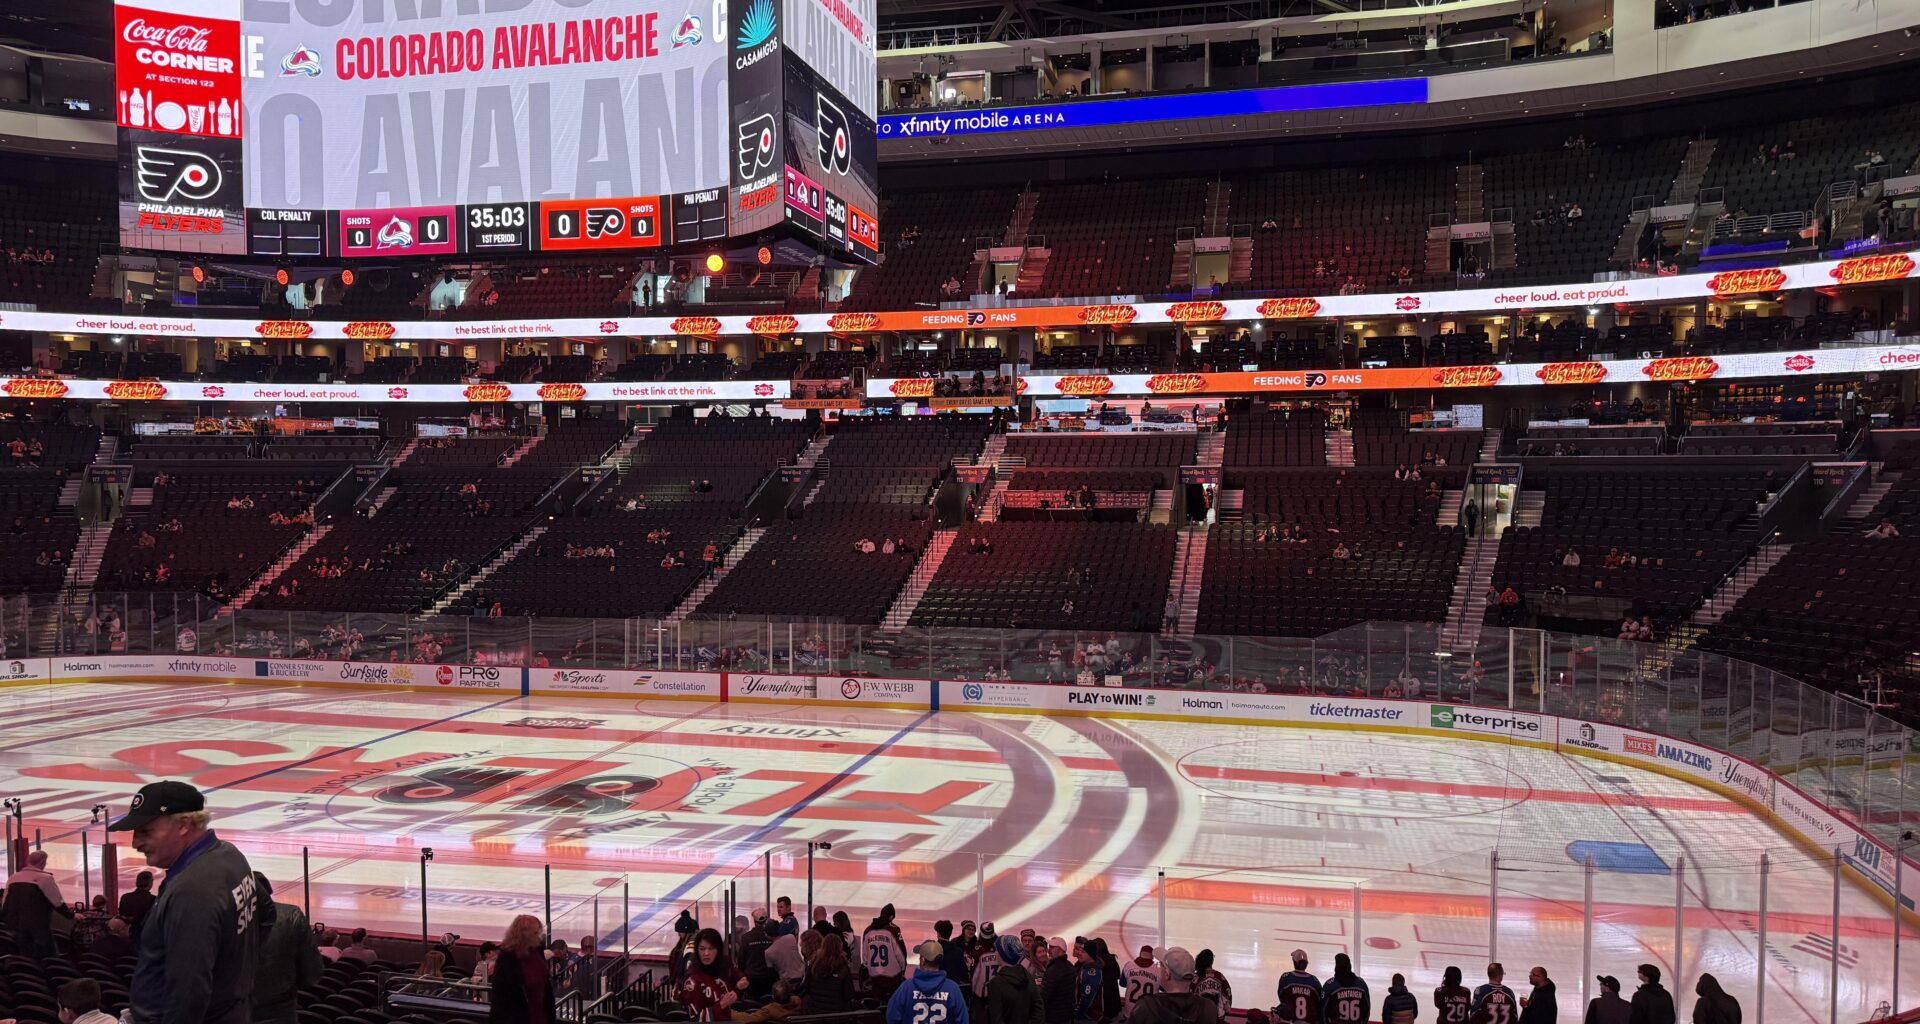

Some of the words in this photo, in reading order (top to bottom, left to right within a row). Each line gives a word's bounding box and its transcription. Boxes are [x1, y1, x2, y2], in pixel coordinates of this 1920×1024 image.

[123, 19, 213, 52] Coca-Cola
[336, 28, 483, 80] COLORADO
[492, 12, 658, 70] AVALANCHE
[736, 37, 778, 70] CASAMIGOS
[136, 48, 234, 74] CORNER
[145, 73, 157, 81] AT
[158, 75, 198, 86] SECTION
[900, 116, 951, 136] xfinity
[954, 112, 1009, 131] mobile
[1012, 112, 1065, 126] ARENA
[739, 172, 778, 195] PHILADELPHIA
[684, 193, 694, 205] PHI
[695, 189, 719, 204] PENALTY
[739, 184, 778, 213] FLYERS
[812, 190, 817, 208] 0
[138, 203, 225, 218] PHILADELPHIA
[261, 210, 277, 221] COL
[278, 210, 311, 222] PENALTY
[470, 206, 525, 228] 35:03
[630, 205, 654, 214] SHOTS
[826, 196, 845, 224] 35:03
[138, 212, 224, 234] FLYERS
[346, 217, 371, 225] SHOTS
[558, 214, 571, 235] 0
[638, 219, 647, 235] 0
[427, 219, 439, 240] 0
[355, 231, 364, 245] 0
[481, 235, 492, 244] 1ST
[493, 234, 515, 244] PERIOD
[1494, 293, 1528, 304] cheer
[1530, 290, 1560, 302] loud.
[1563, 289, 1586, 301] eat
[1587, 287, 1629, 302] proud.
[76, 319, 107, 329] cheer
[110, 319, 138, 330] loud.
[139, 322, 158, 331] eat
[160, 322, 196, 334] proud.
[922, 314, 964, 325] FEEDING
[990, 313, 1017, 322] FANS
[455, 326, 470, 334] the
[471, 326, 490, 334] best
[491, 325, 507, 334] link
[508, 326, 518, 334] at
[519, 325, 534, 333] the
[535, 324, 554, 333] rink.
[1879, 352, 1920, 365] cheer
[1253, 376, 1301, 386] FEEDING
[1332, 374, 1362, 384] FANS
[253, 389, 282, 398] cheer
[283, 388, 308, 398] loud.
[310, 391, 328, 399] eat
[329, 390, 359, 400] proud.
[612, 387, 627, 396] the
[629, 387, 649, 396] best
[650, 387, 666, 396] link
[667, 388, 678, 396] at
[678, 387, 694, 396] the
[696, 386, 716, 396] rink.
[64, 662, 101, 671] Holman
[168, 659, 201, 672] xfinity
[204, 660, 237, 672] mobile
[275, 669, 310, 678] BUCKELEW
[340, 662, 388, 680] Surfside
[460, 666, 500, 681] PRO
[460, 680, 500, 688] PARTNER
[569, 670, 607, 684] Sports
[653, 681, 706, 691] Constellation
[741, 675, 803, 696] Yuengling
[883, 682, 914, 693] WEBB
[1068, 692, 1099, 704] PLAY
[1112, 693, 1142, 706] WIN!
[1182, 698, 1223, 709] Holman
[1309, 702, 1403, 720] ticketmaster
[1433, 711, 1539, 731] enterprise
[710, 724, 849, 738] xfinity
[1627, 739, 1653, 752] MIKE'S
[1658, 743, 1712, 771] AMAZING
[1719, 756, 1768, 799] Yuengling
[1781, 797, 1794, 812] BANK
[1794, 807, 1801, 816] OF
[1801, 811, 1824, 832] AMERICA
[869, 944, 889, 968] 29
[912, 990, 949, 1001] FAAN
[1292, 986, 1311, 997] MAKAR
[1492, 993, 1506, 1003] ROY
[912, 1002, 948, 1024] 22
[1295, 996, 1307, 1020] 8
[1339, 1000, 1360, 1021] 96
[1446, 1003, 1466, 1022] 29
[1487, 1003, 1511, 1024] 33
